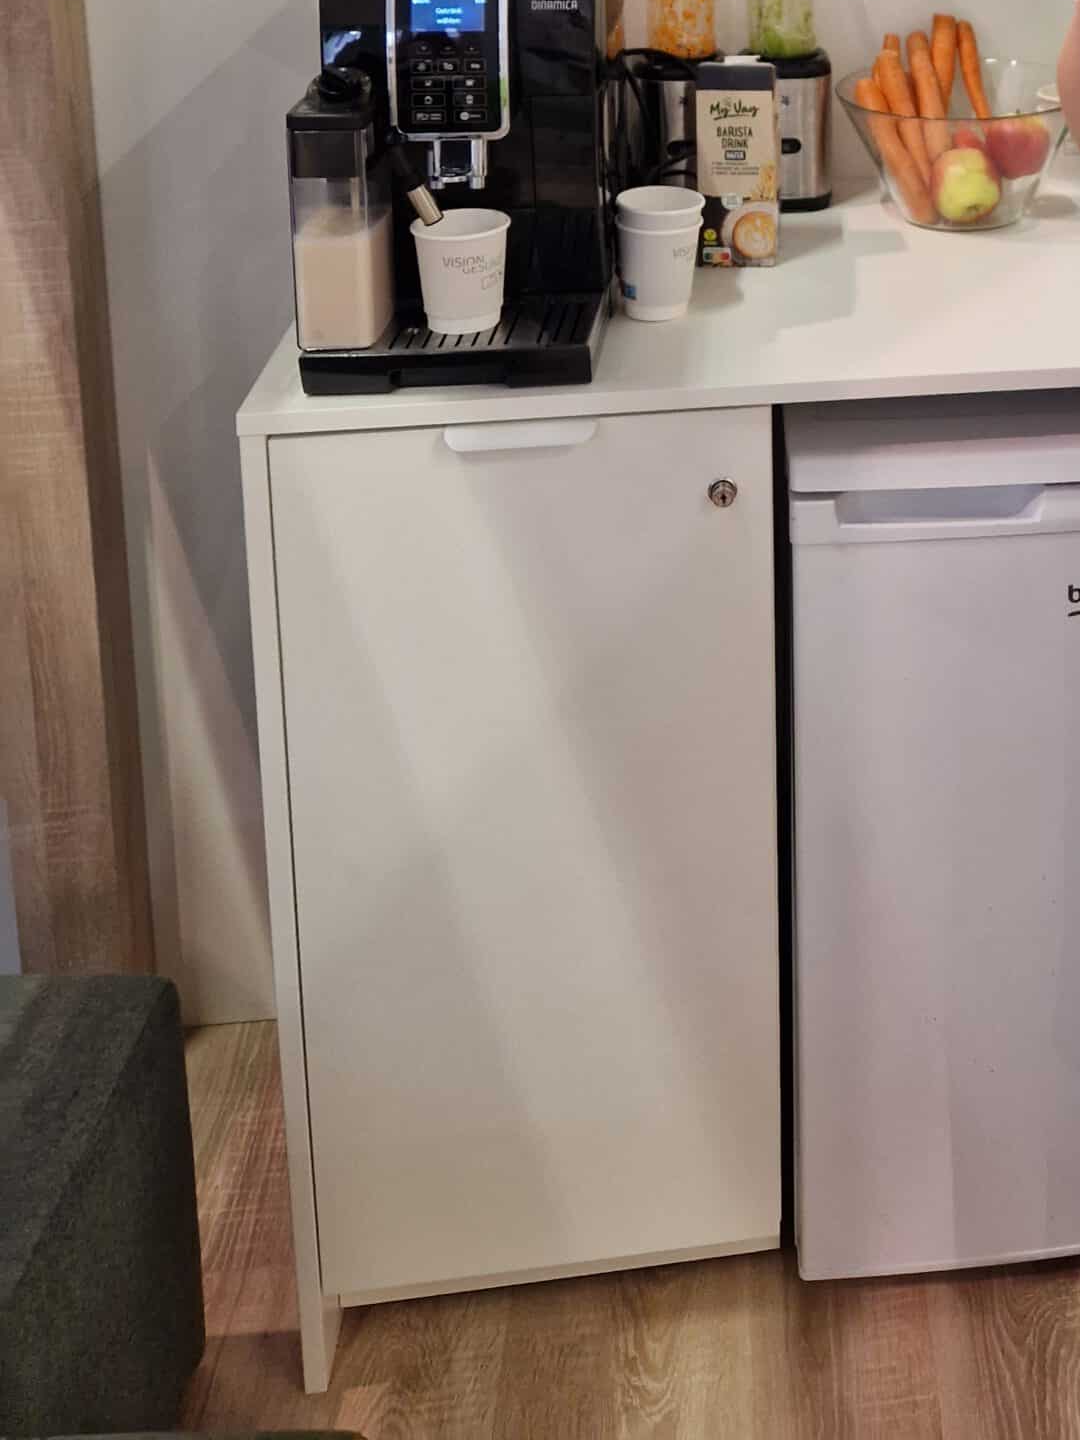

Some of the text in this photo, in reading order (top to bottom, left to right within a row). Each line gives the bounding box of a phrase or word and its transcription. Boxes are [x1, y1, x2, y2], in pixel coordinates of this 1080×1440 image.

[709, 101, 730, 118] My
[717, 126, 753, 137] BARISTA
[721, 138, 748, 149] DRINK
[442, 255, 485, 269] VISION
